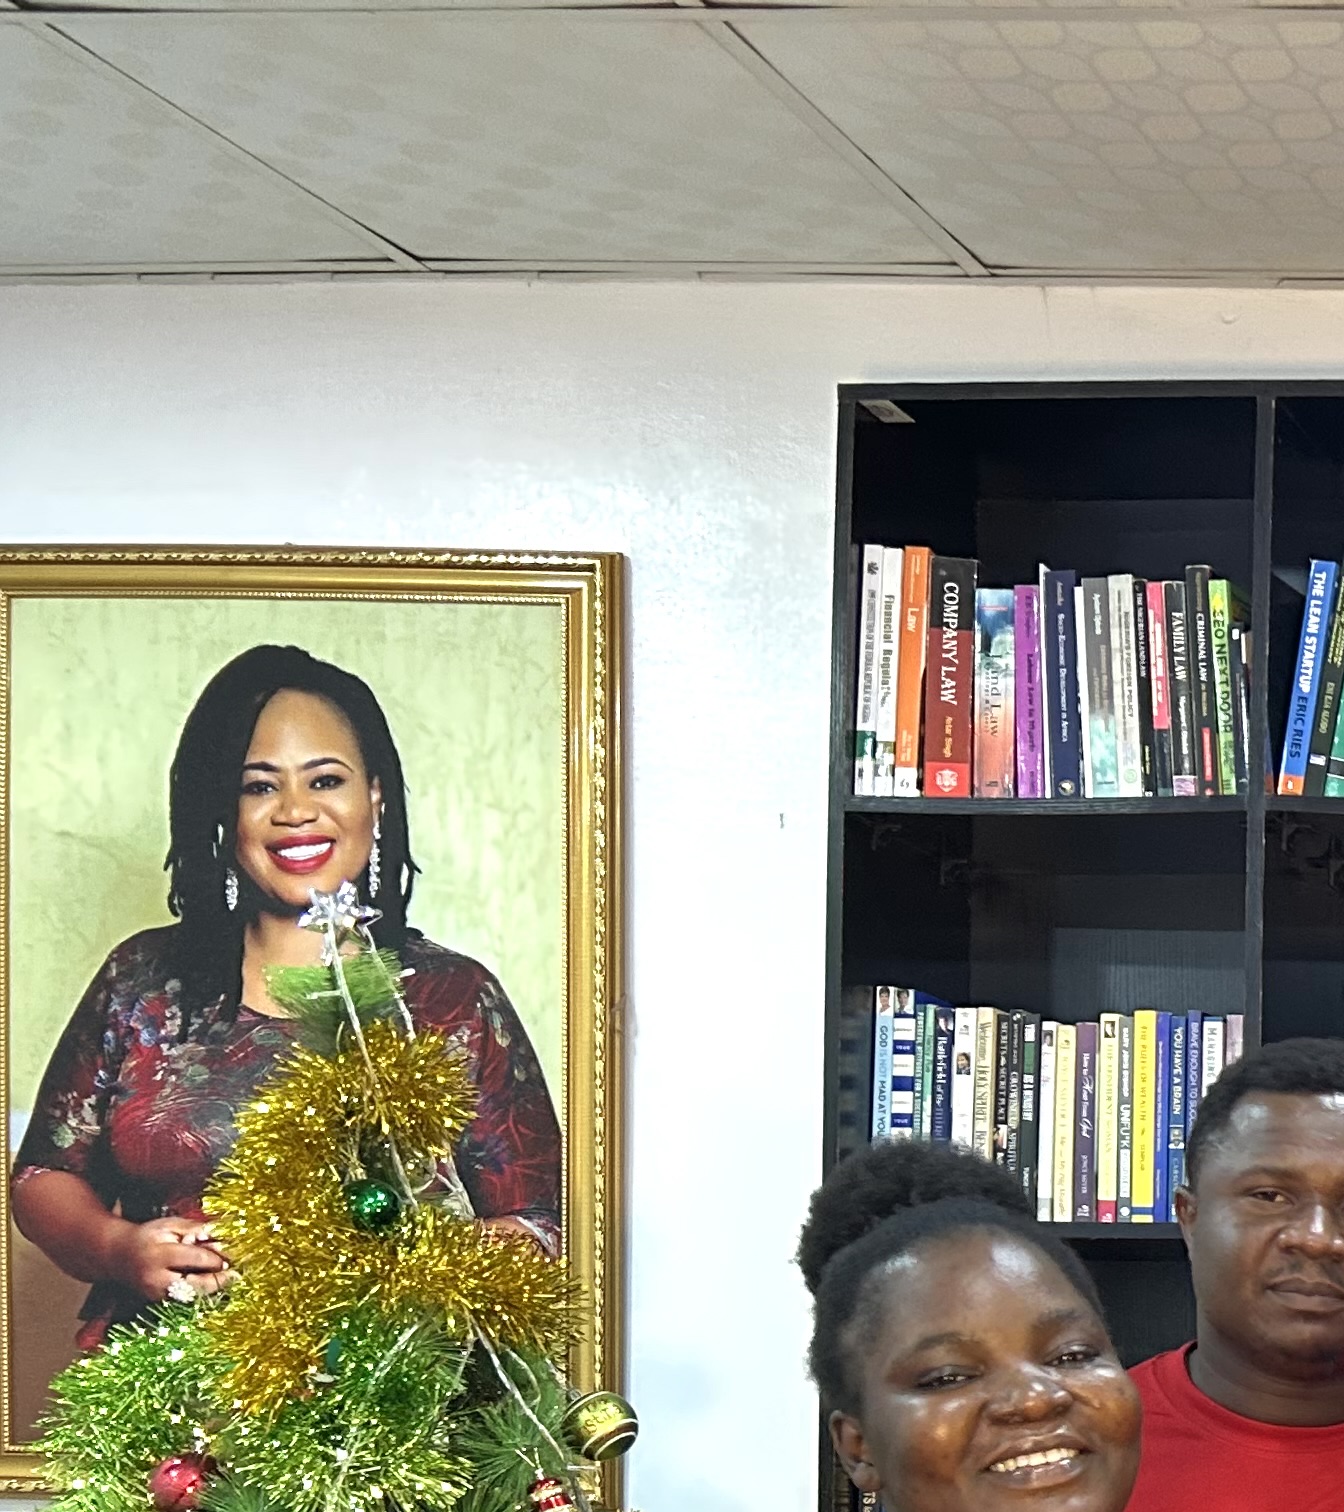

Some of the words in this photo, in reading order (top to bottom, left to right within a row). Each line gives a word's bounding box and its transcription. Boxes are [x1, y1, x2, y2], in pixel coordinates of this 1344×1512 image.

[1312, 571, 1327, 596] THE
[883, 595, 895, 643] Financial
[907, 608, 920, 632] Law
[941, 582, 959, 664] COMPANY
[1306, 599, 1324, 632] LEAN
[1171, 612, 1185, 654] FAMILY
[1196, 613, 1206, 659] CRIMINAL
[1173, 656, 1186, 681] LAW
[1198, 662, 1207, 681] LAW
[1214, 643, 1229, 686] NEXT
[1299, 635, 1318, 693] STARTUP
[940, 666, 957, 705] LAW
[990, 704, 1001, 738] Law
[1216, 691, 1231, 733] DOOR
[1294, 695, 1308, 725] ERIC
[1289, 729, 1303, 759] RIES
[879, 1025, 888, 1048] GOD
[1000, 1021, 1008, 1056] SECRETS
[1174, 1028, 1184, 1048] YOU
[1190, 1022, 1198, 1048] BRAVE
[1173, 1050, 1183, 1075] HAVE
[1207, 1027, 1217, 1078] MANAGING
[878, 1059, 888, 1079] NOT
[976, 1065, 990, 1088] HOLY
[879, 1080, 889, 1101] MAD
[1172, 1085, 1181, 1115] BRAIN
[1190, 1088, 1197, 1098] TO
[878, 1103, 887, 1115] AT
[975, 1092, 988, 1122] SPIRIT
[877, 1117, 886, 1137] YOU
[1079, 1118, 1094, 1138] God
